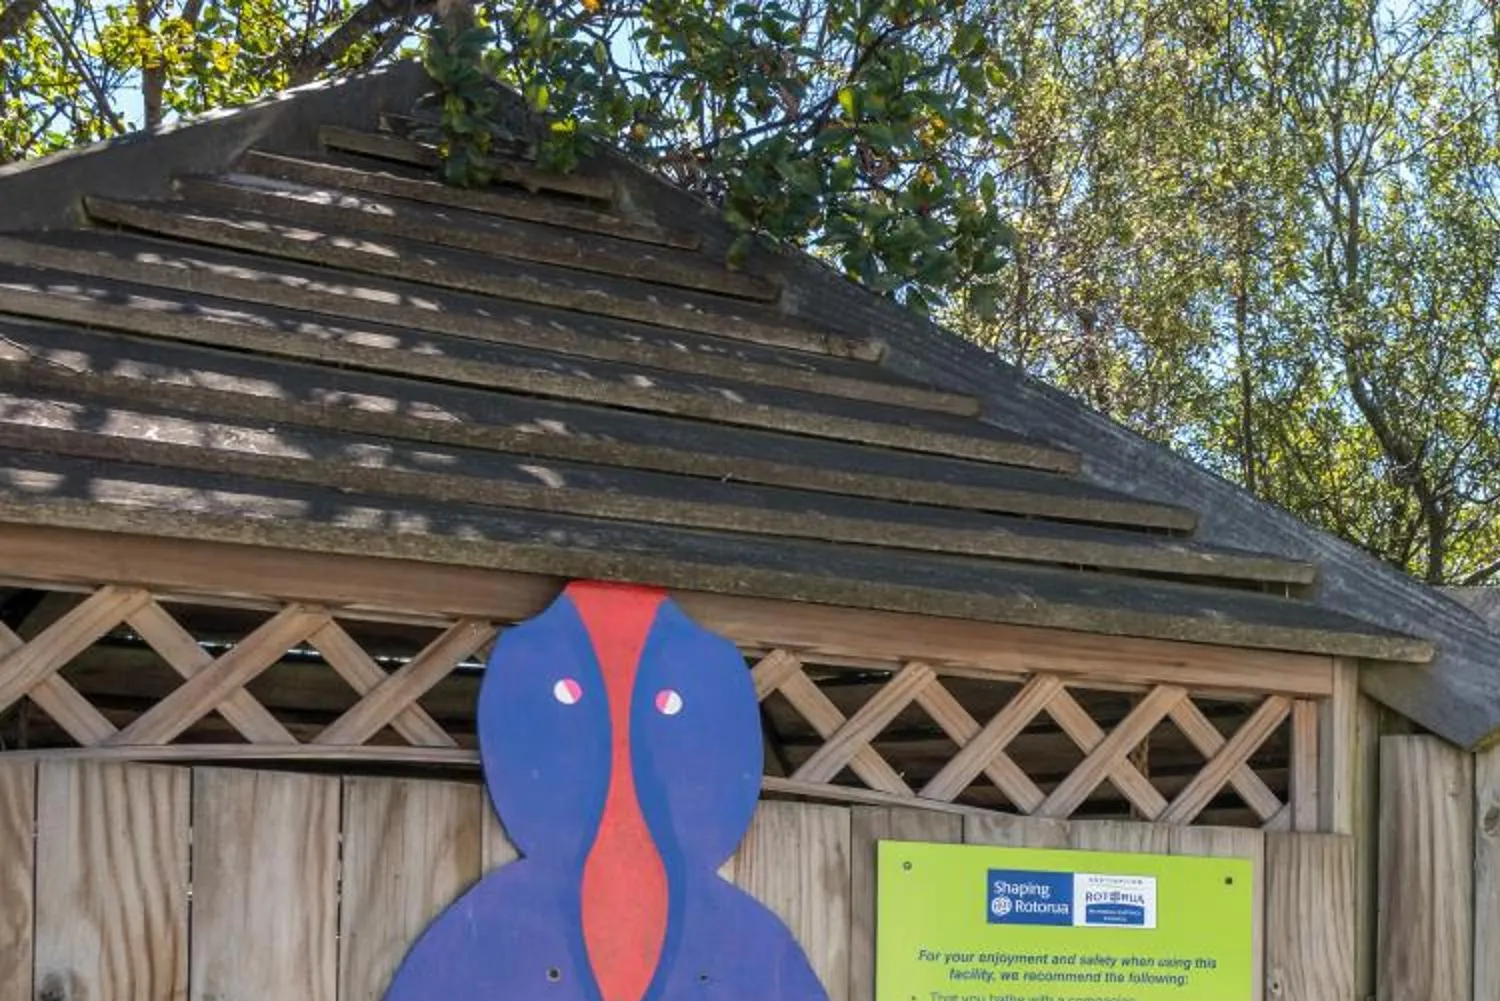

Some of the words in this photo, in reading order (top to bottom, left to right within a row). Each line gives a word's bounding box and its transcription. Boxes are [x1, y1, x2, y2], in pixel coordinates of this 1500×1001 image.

[993, 880, 1050, 898] Shaping
[1015, 900, 1069, 915] Rotorua
[918, 950, 941, 961] For
[944, 953, 974, 965] your
[978, 952, 1048, 966] enjoyment
[1051, 954, 1076, 965] and
[1121, 955, 1154, 967] when
[1158, 958, 1192, 969] using
[1195, 958, 1217, 968] this
[1001, 972, 1019, 981] we
[1023, 973, 1101, 982] recommend
[1105, 973, 1124, 982] the
